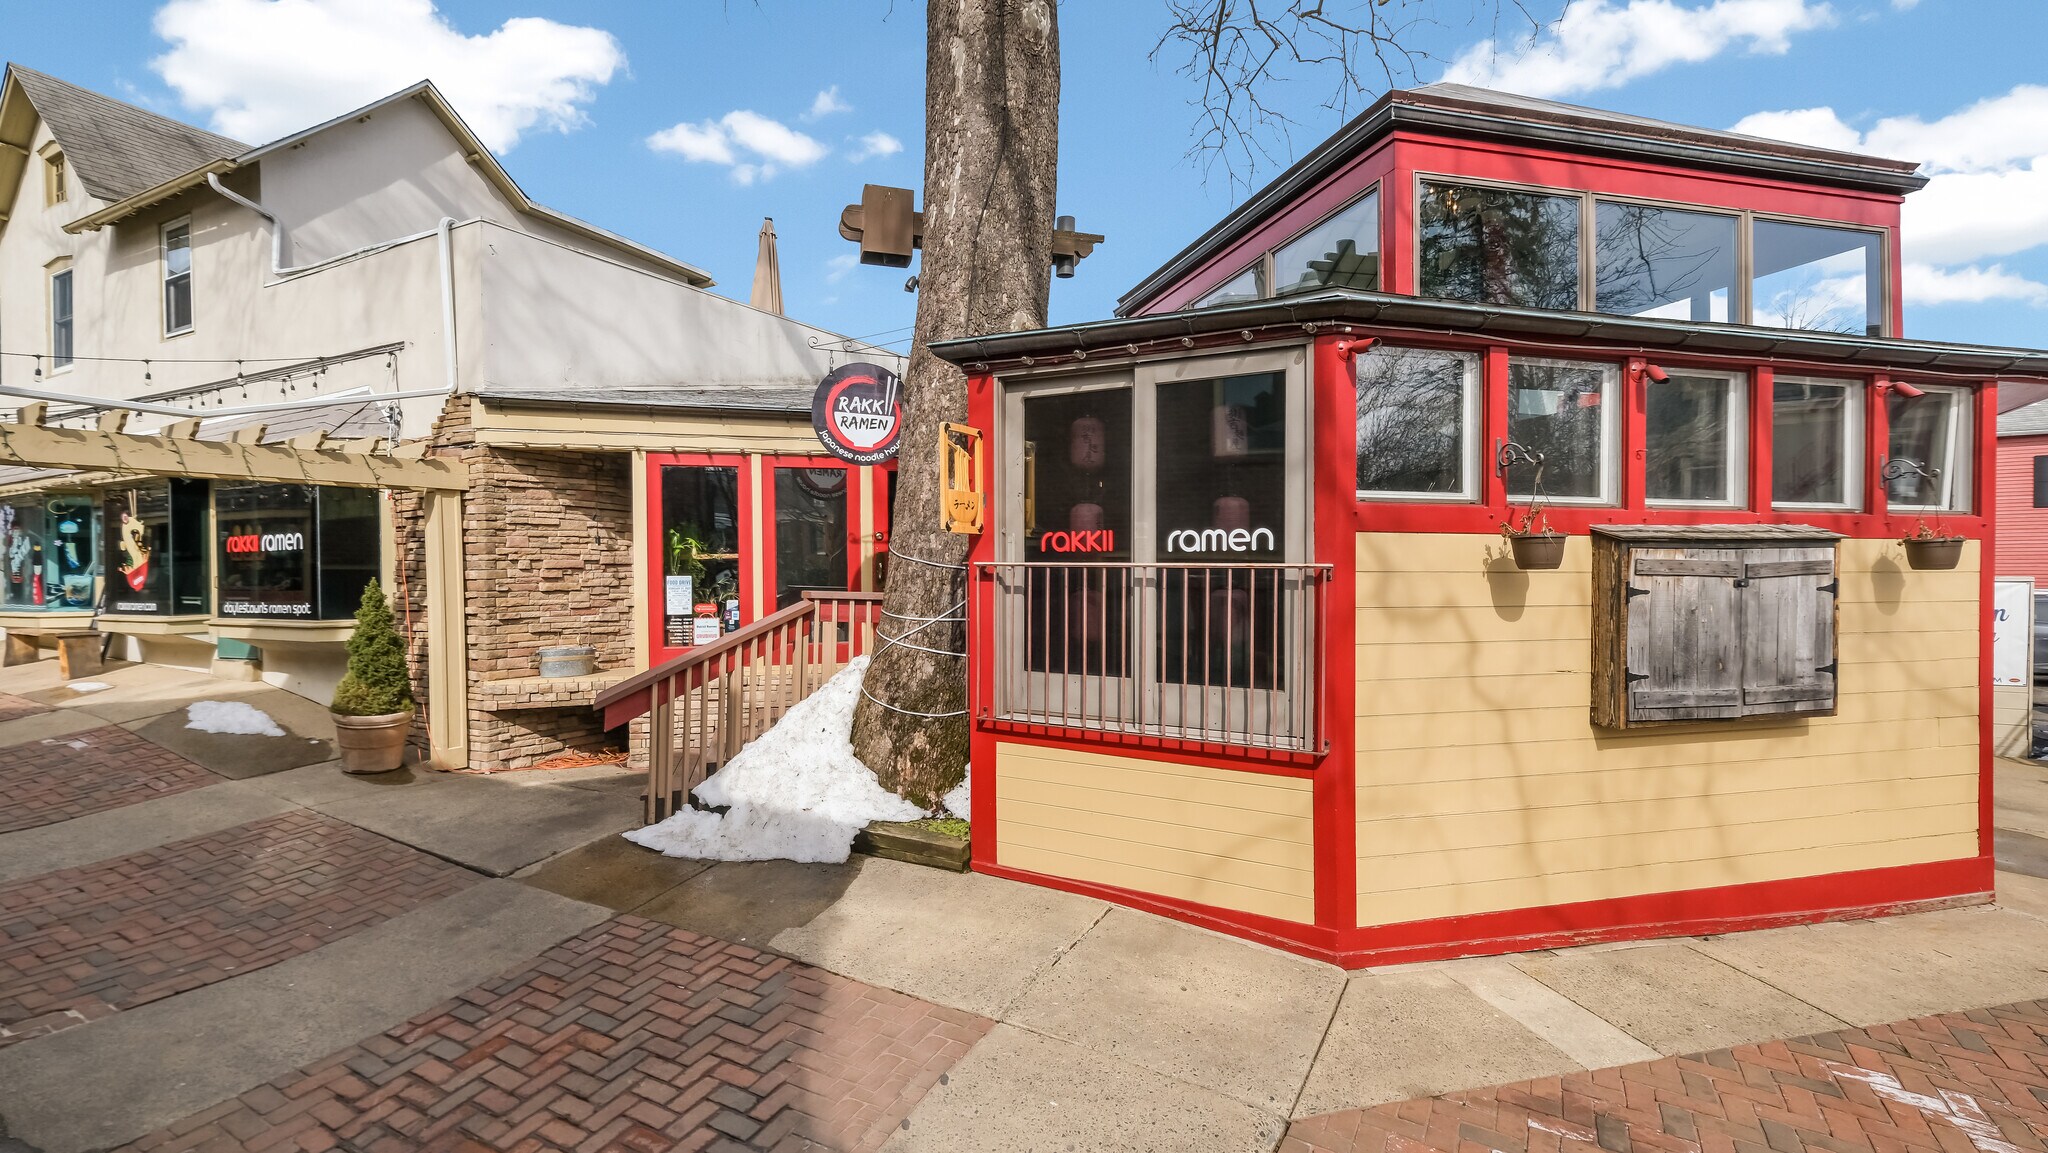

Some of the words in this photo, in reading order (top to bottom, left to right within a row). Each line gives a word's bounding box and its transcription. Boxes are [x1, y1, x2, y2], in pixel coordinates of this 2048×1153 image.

[840, 415, 889, 431] RAMEN
[854, 452, 885, 462] noodle
[953, 499, 976, 510] ラーメン
[261, 532, 304, 552] ramen
[1167, 527, 1275, 552] ramen
[268, 604, 292, 614] ramen
[292, 602, 312, 617] spot
